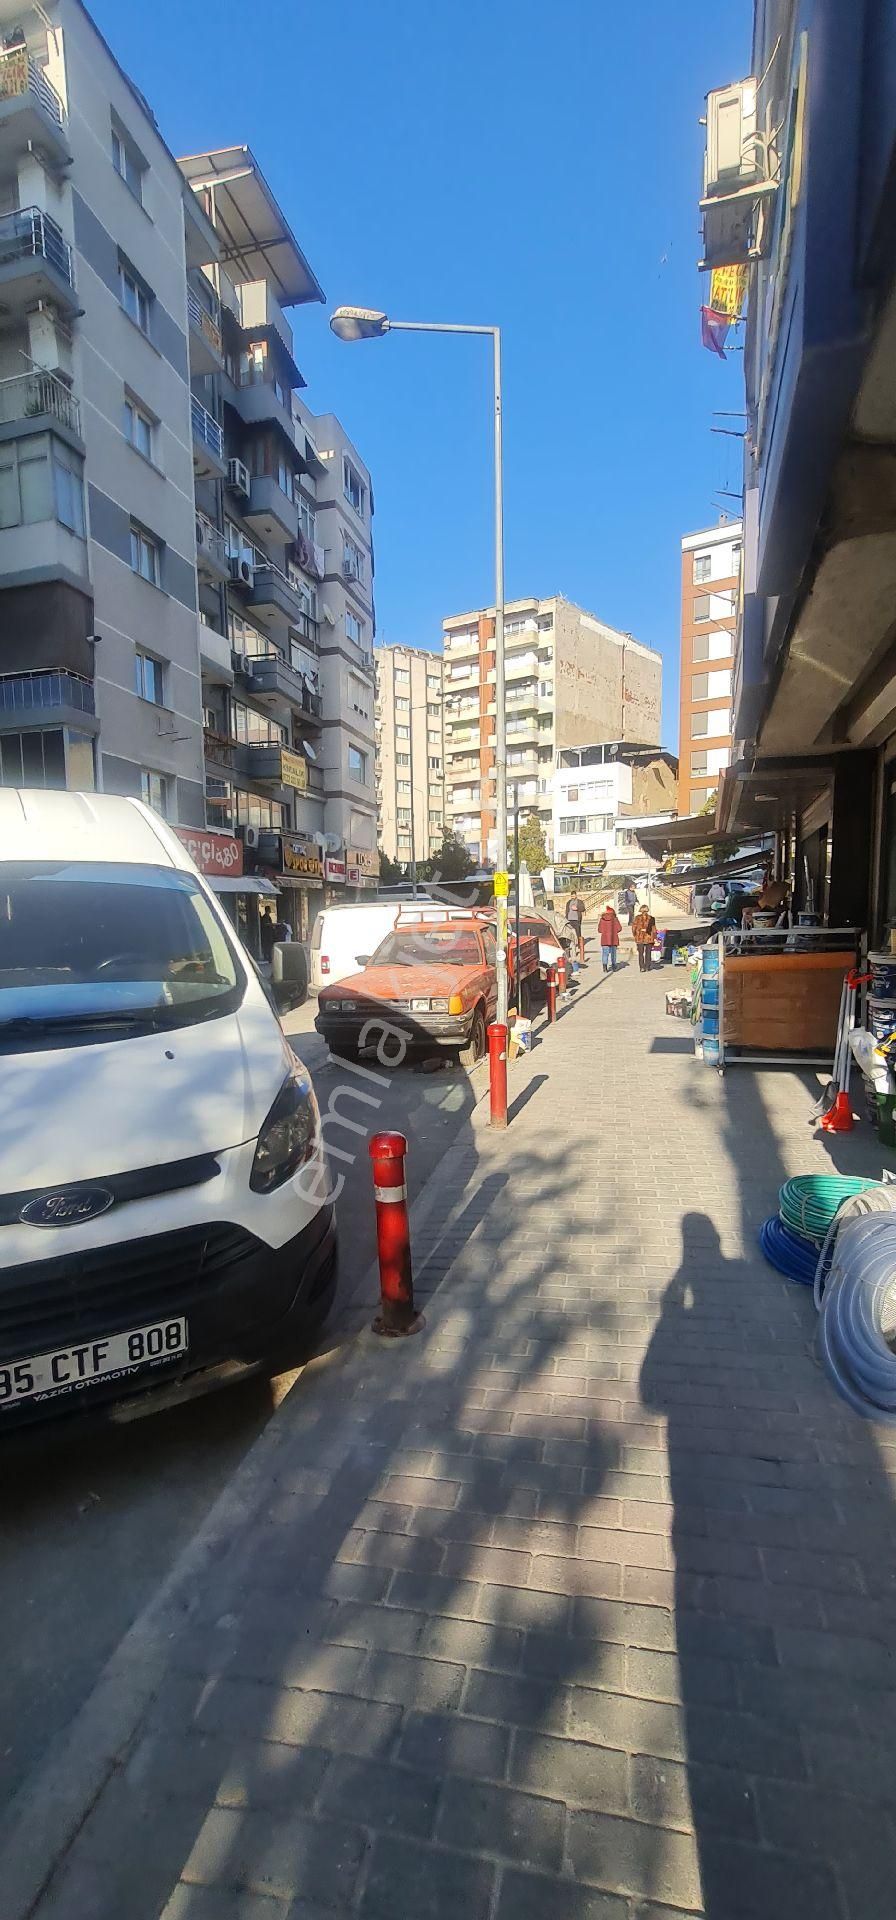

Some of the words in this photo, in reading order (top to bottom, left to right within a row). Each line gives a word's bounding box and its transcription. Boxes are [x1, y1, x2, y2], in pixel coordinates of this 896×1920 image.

[42, 1196, 92, 1220] Ford
[51, 1341, 109, 1384] CTF
[127, 1322, 182, 1361] 808
